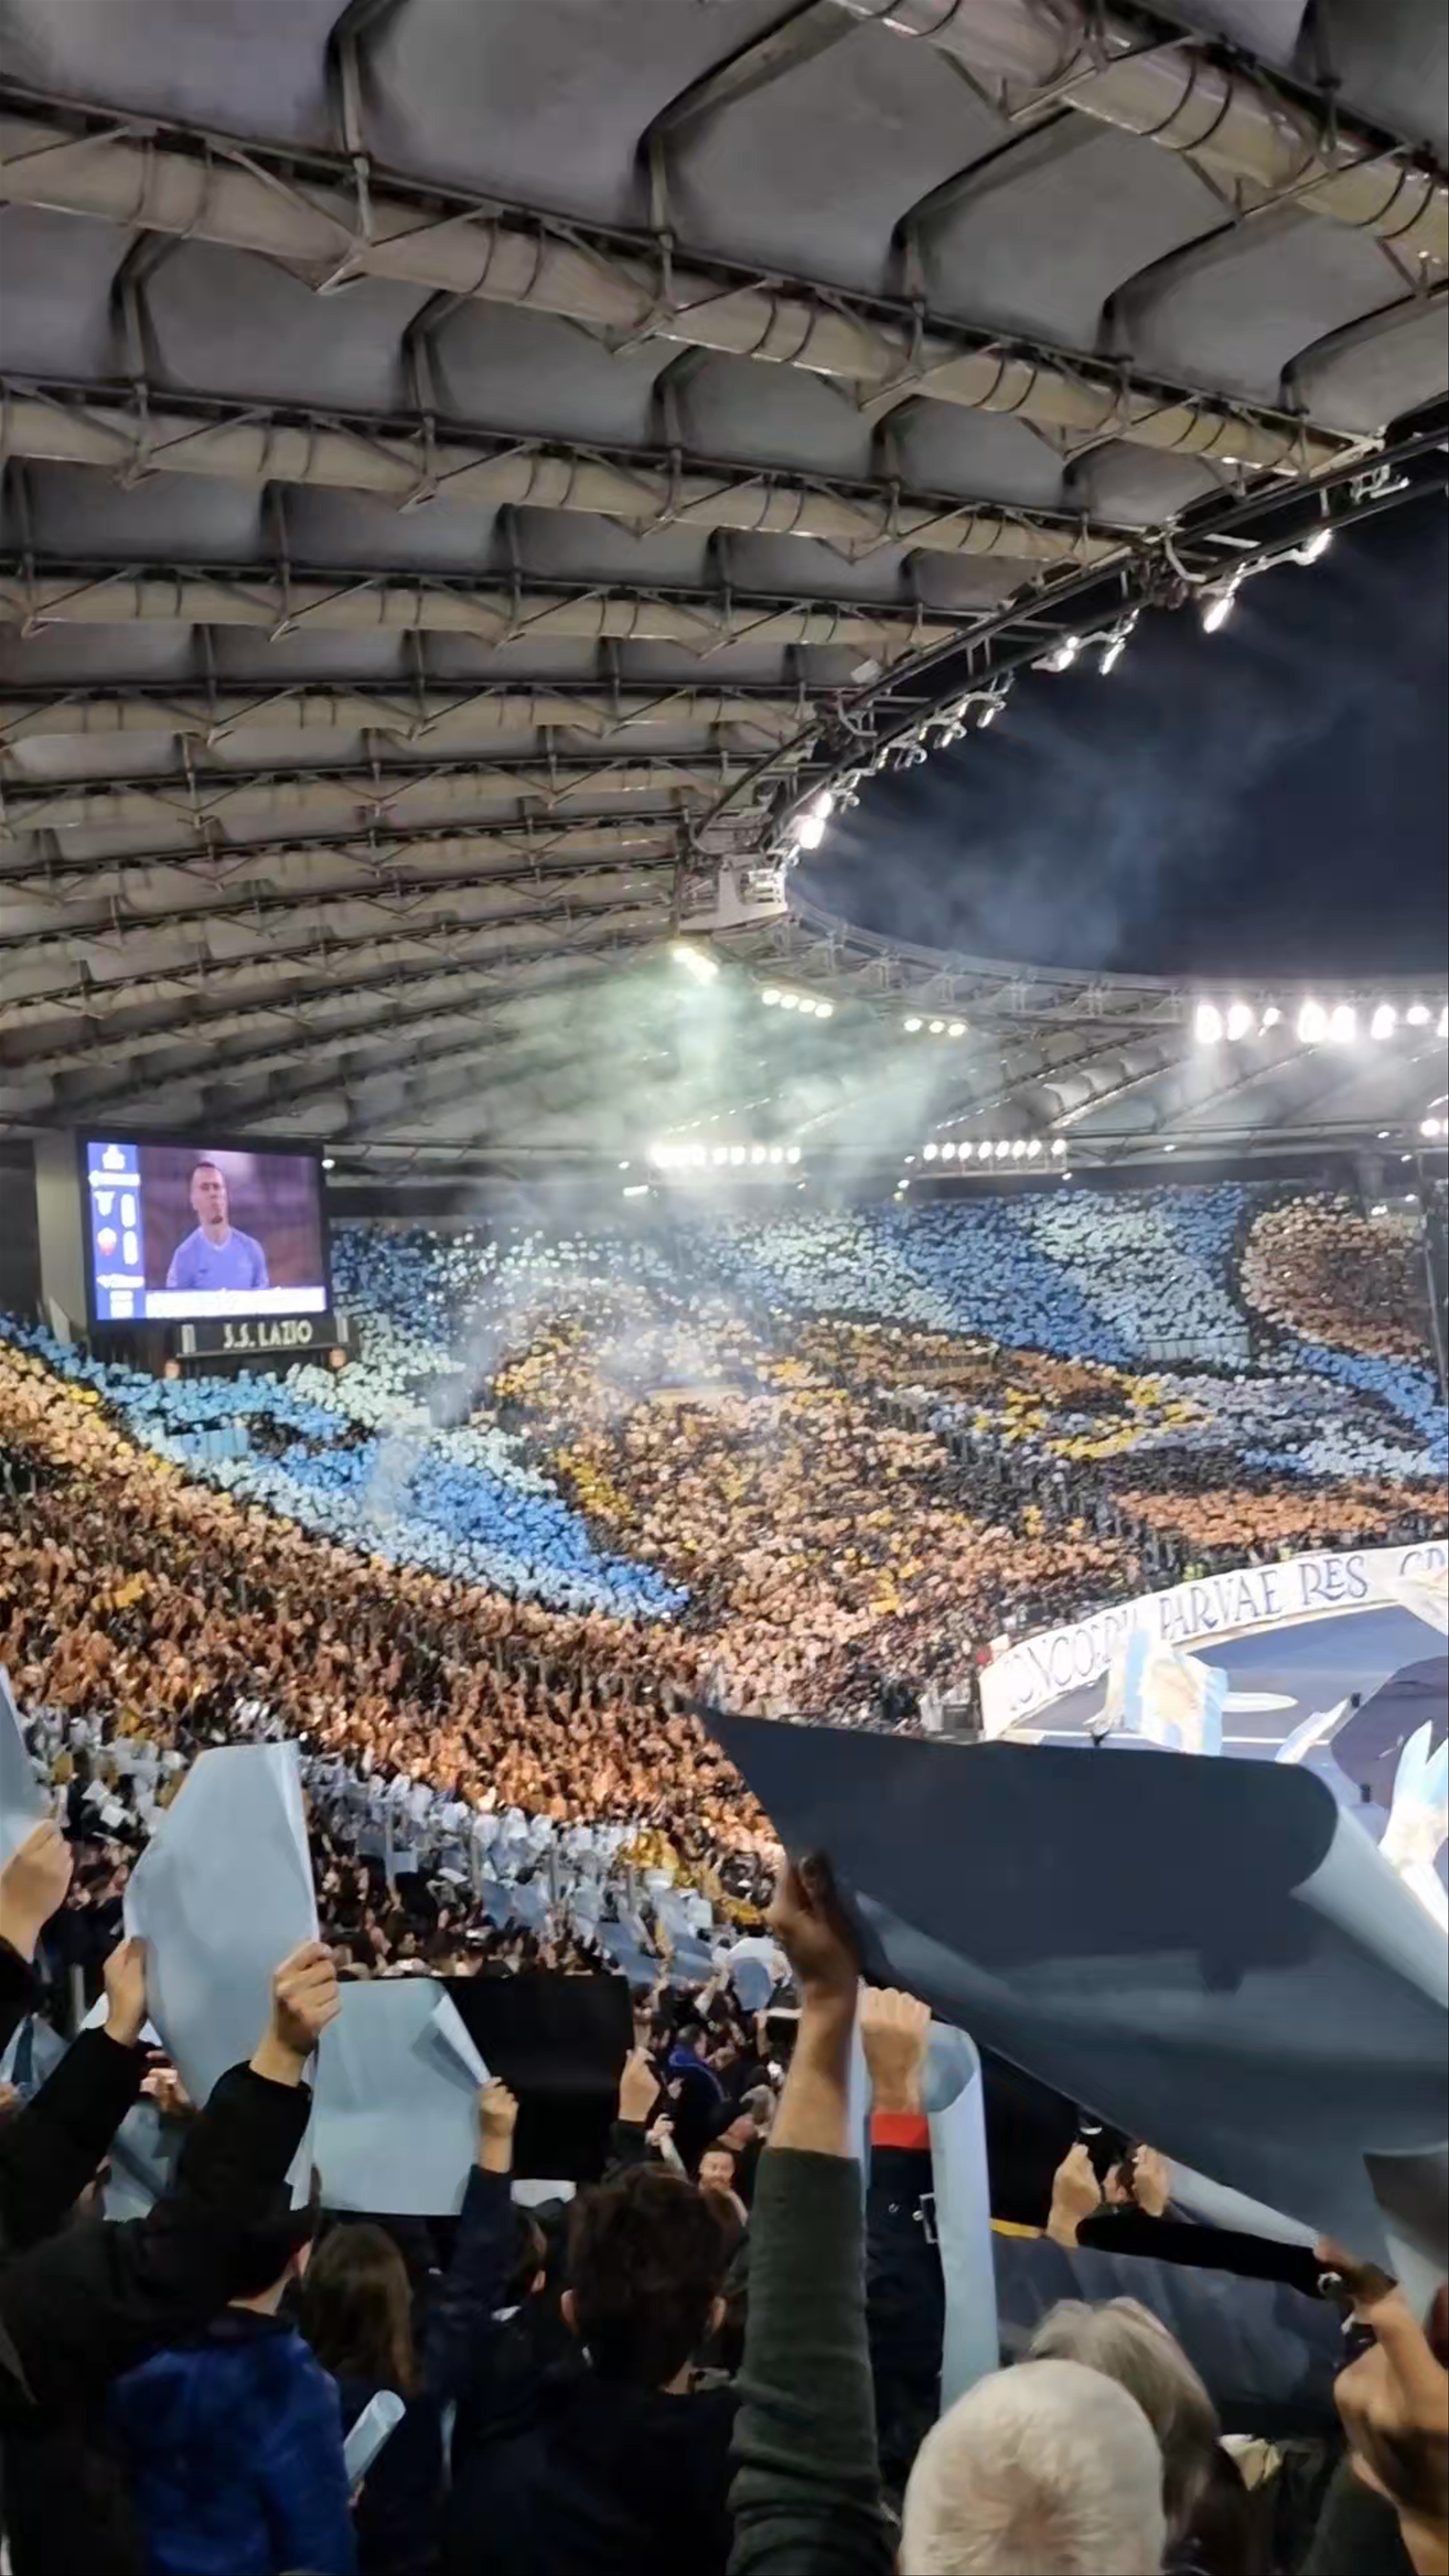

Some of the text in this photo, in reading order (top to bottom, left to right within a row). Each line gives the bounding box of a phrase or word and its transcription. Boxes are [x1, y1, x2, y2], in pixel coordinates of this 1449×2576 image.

[224, 1320, 312, 1348] S.S. LAZIO
[1160, 1570, 1282, 1640] PARVAE
[1298, 1555, 1367, 1605] RES
